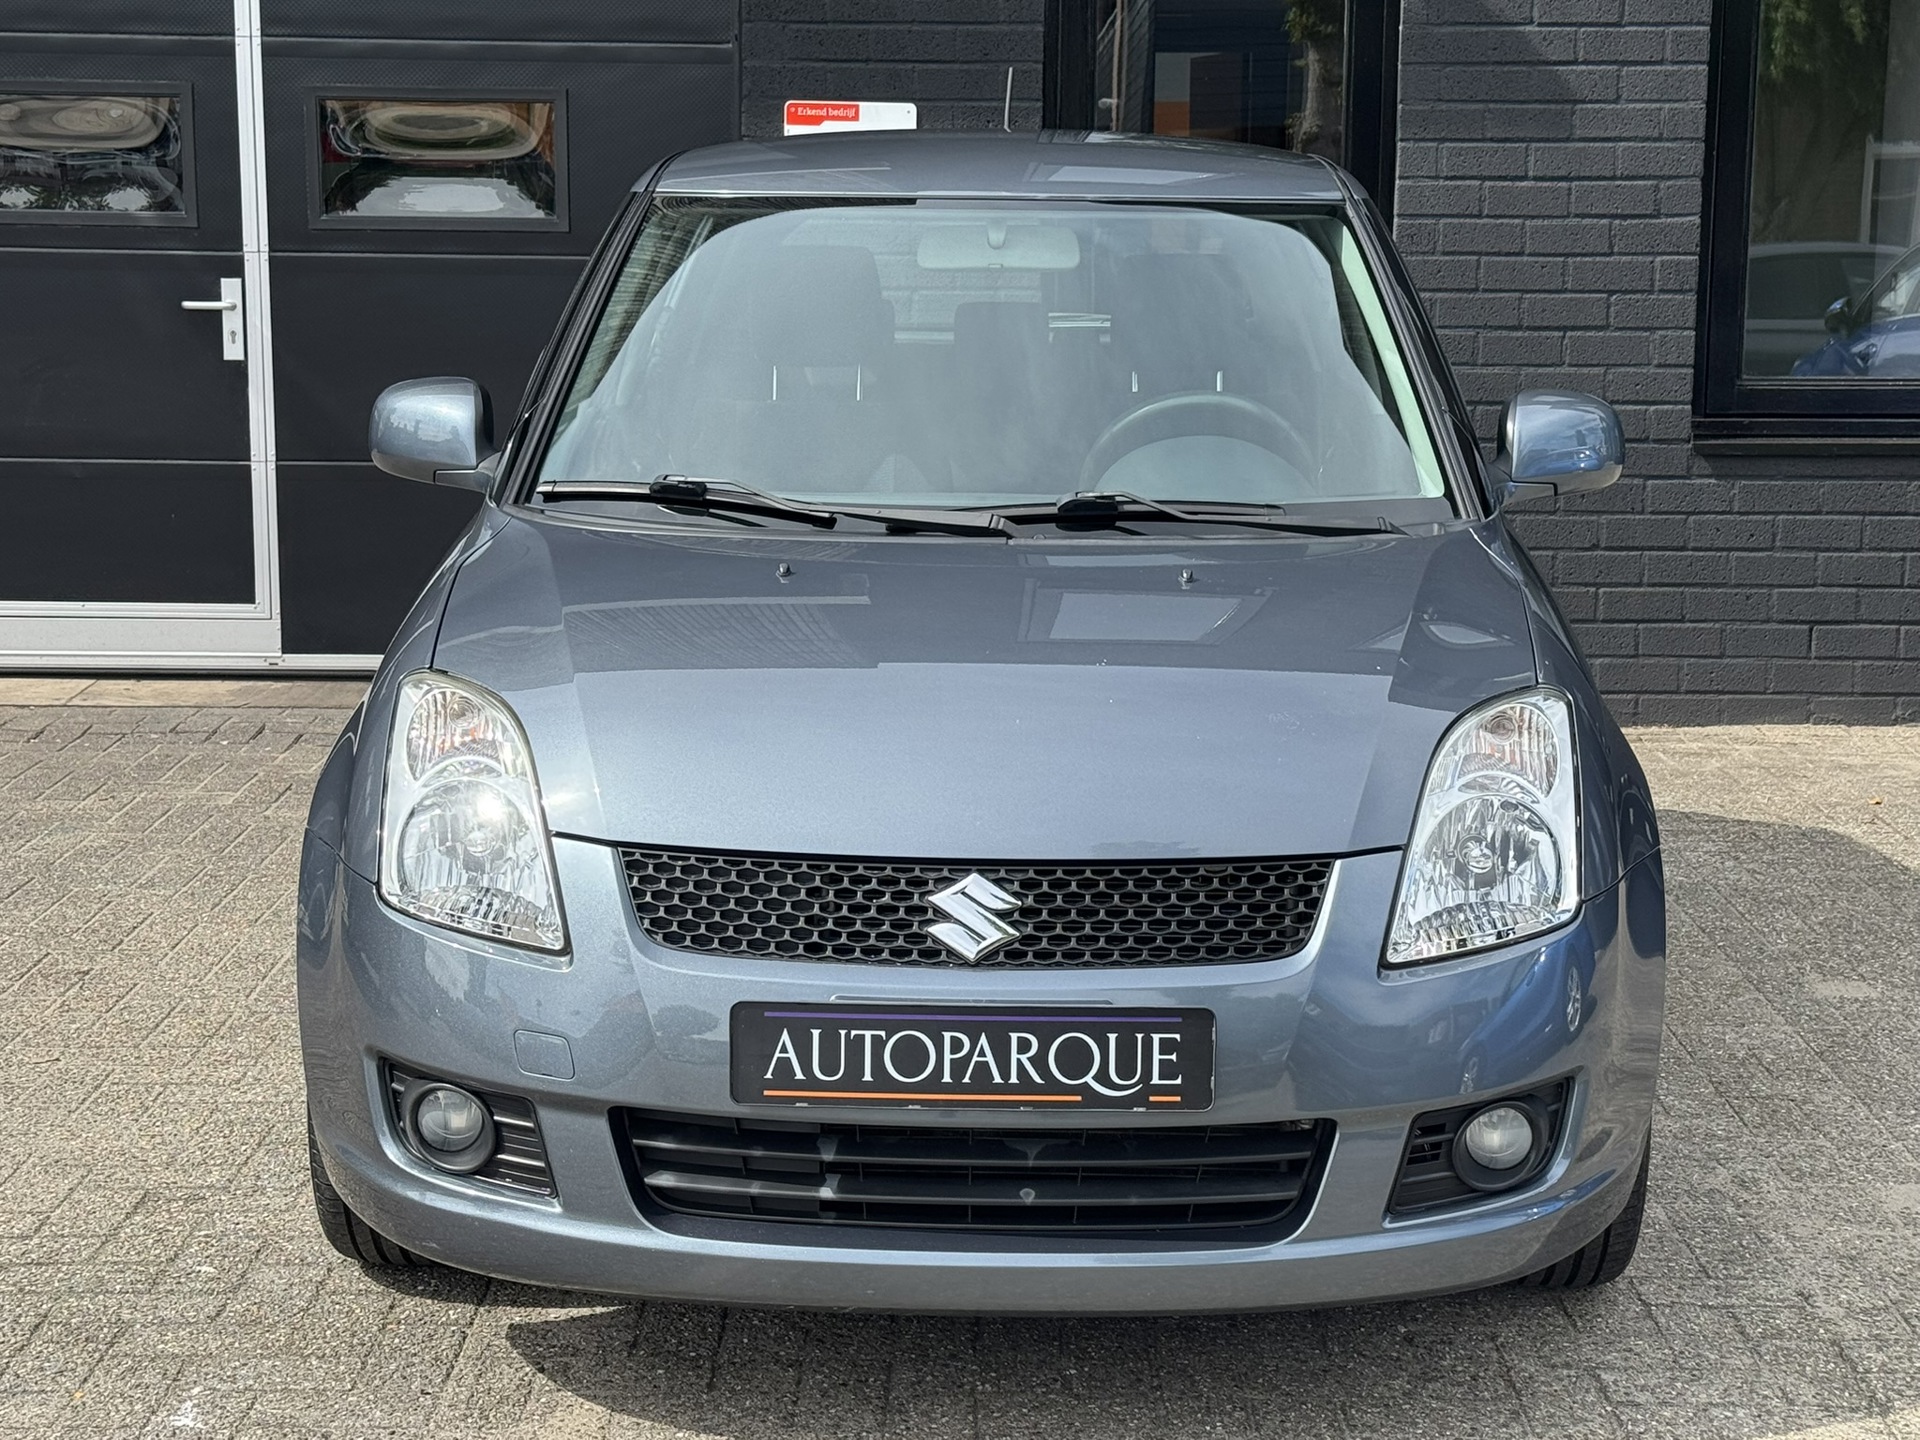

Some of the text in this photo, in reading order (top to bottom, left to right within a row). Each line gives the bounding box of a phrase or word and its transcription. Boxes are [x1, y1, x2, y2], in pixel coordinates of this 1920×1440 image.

[797, 107, 856, 118] Erkend bedrijf
[763, 1028, 1183, 1097] AUTOPARQUE
